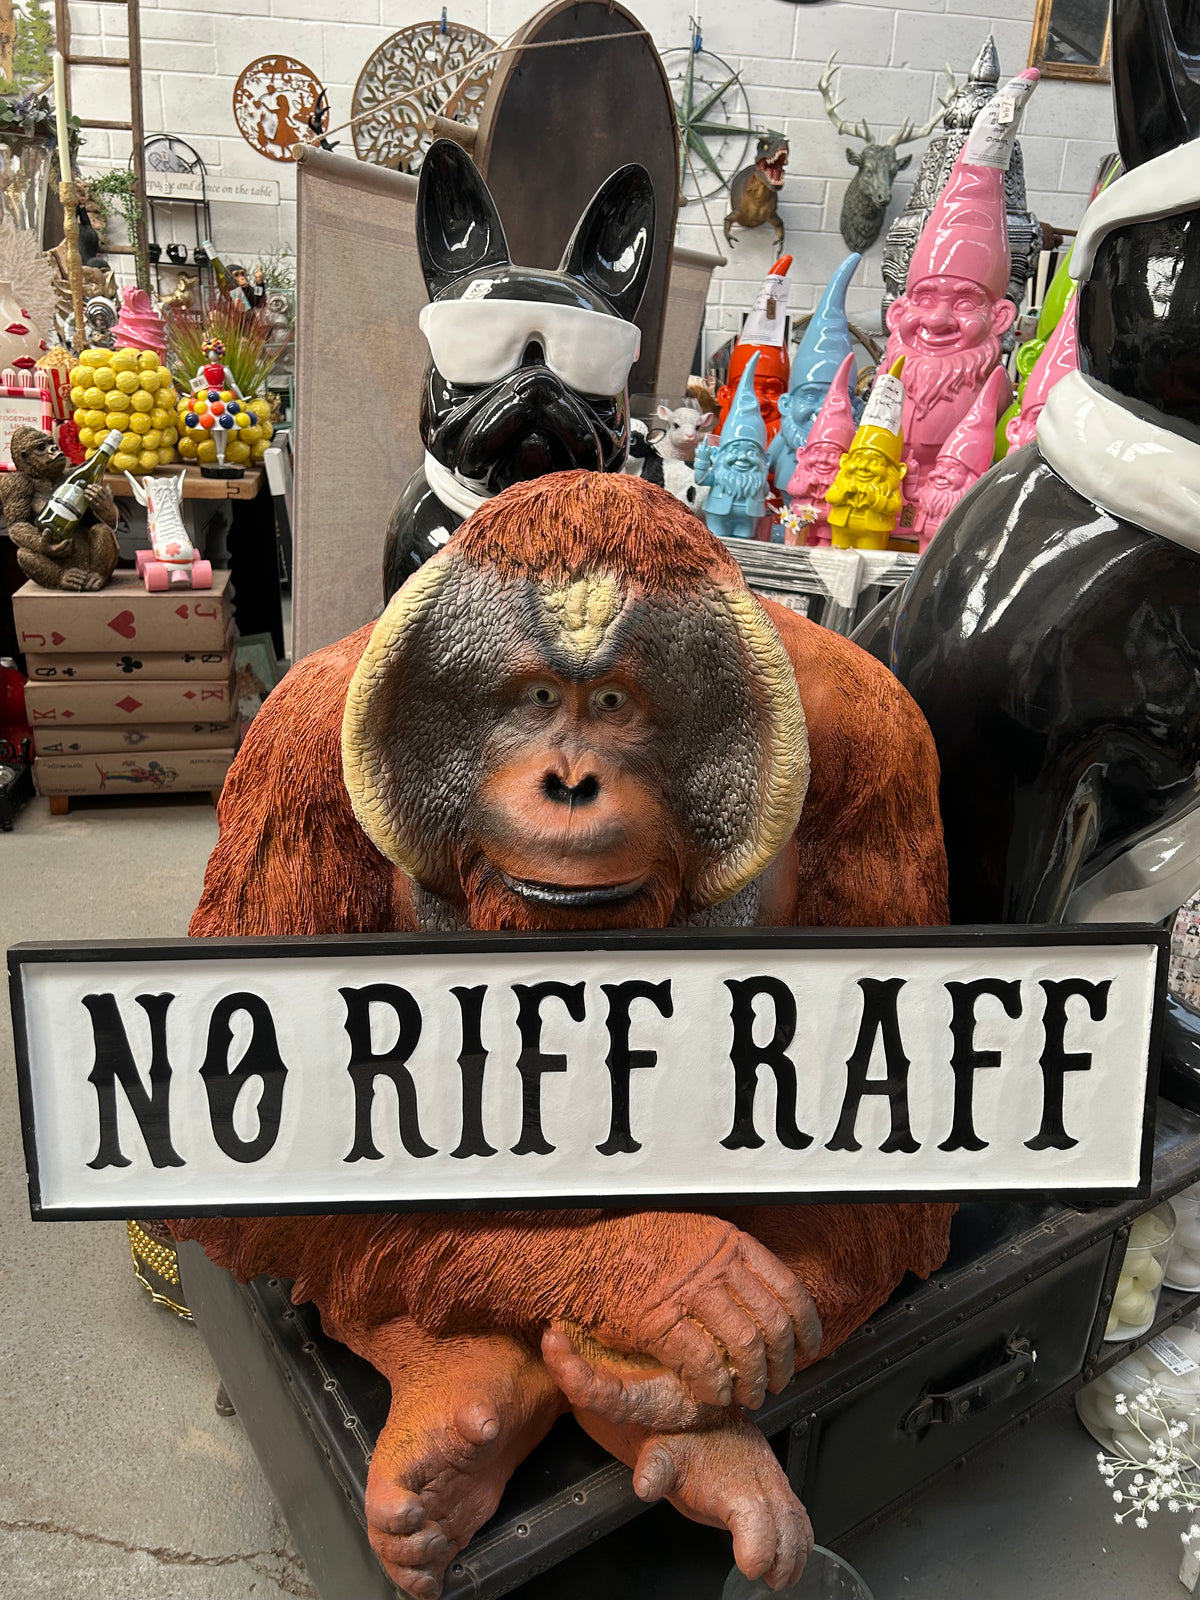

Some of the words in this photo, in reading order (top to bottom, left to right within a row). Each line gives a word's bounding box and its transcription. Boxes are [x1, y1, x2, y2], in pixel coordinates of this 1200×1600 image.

[176, 180, 194, 191] and
[221, 185, 233, 194] on
[235, 184, 249, 195] the
[250, 185, 273, 197] table
[194, 603, 217, 620] J
[22, 631, 46, 647] J
[201, 688, 224, 701] K
[33, 708, 57, 720] K
[82, 992, 288, 1169] NO
[338, 979, 674, 1163] RIFF
[719, 975, 1113, 1154] RAFF
